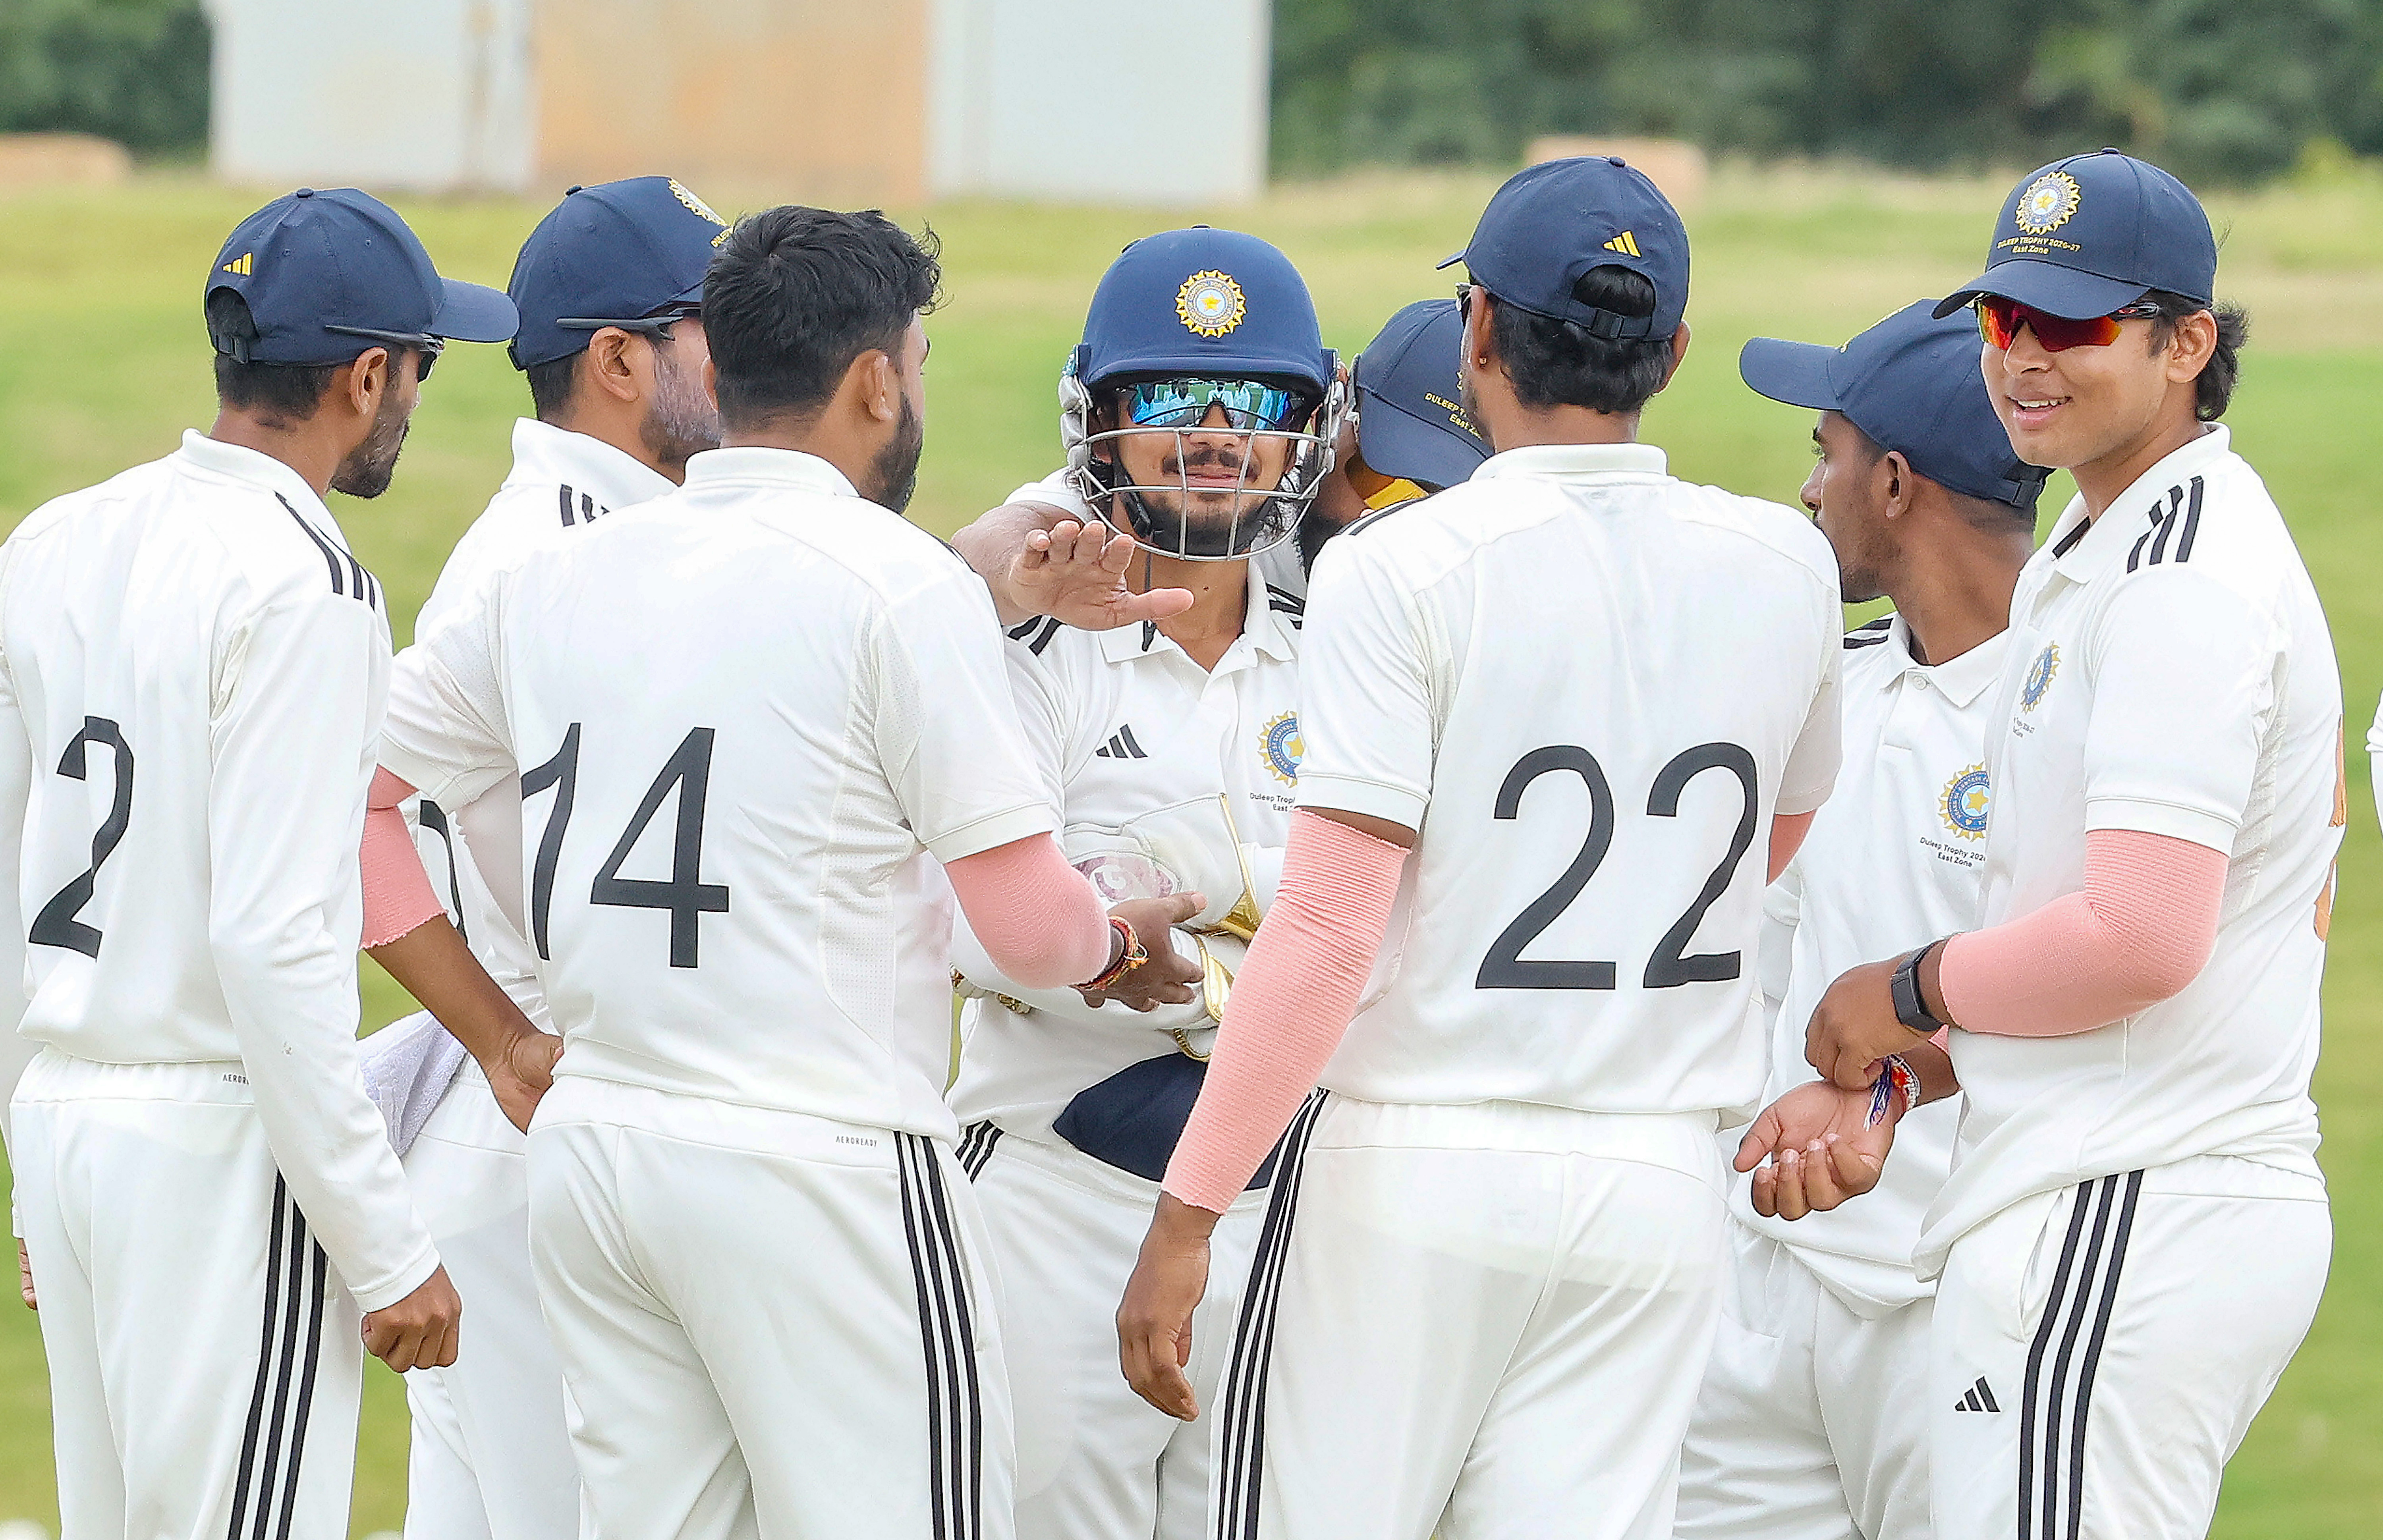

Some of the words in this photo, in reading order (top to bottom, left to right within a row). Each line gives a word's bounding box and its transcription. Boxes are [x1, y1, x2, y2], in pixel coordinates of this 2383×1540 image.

[2028, 245, 2050, 255] Zone
[1425, 392, 1460, 411] DULEEP
[1449, 413, 1470, 429] East
[1250, 792, 1275, 803] Duleep
[1273, 804, 1288, 812] East
[29, 716, 134, 959] 2
[521, 722, 729, 968] 14
[1920, 837, 1942, 850] Duleep
[1944, 844, 1969, 858] Trophy
[1475, 742, 1758, 990] 22
[1937, 852, 1952, 863] East
[1954, 857, 1973, 867] Zone
[836, 1135, 877, 1147] AEROREADY
